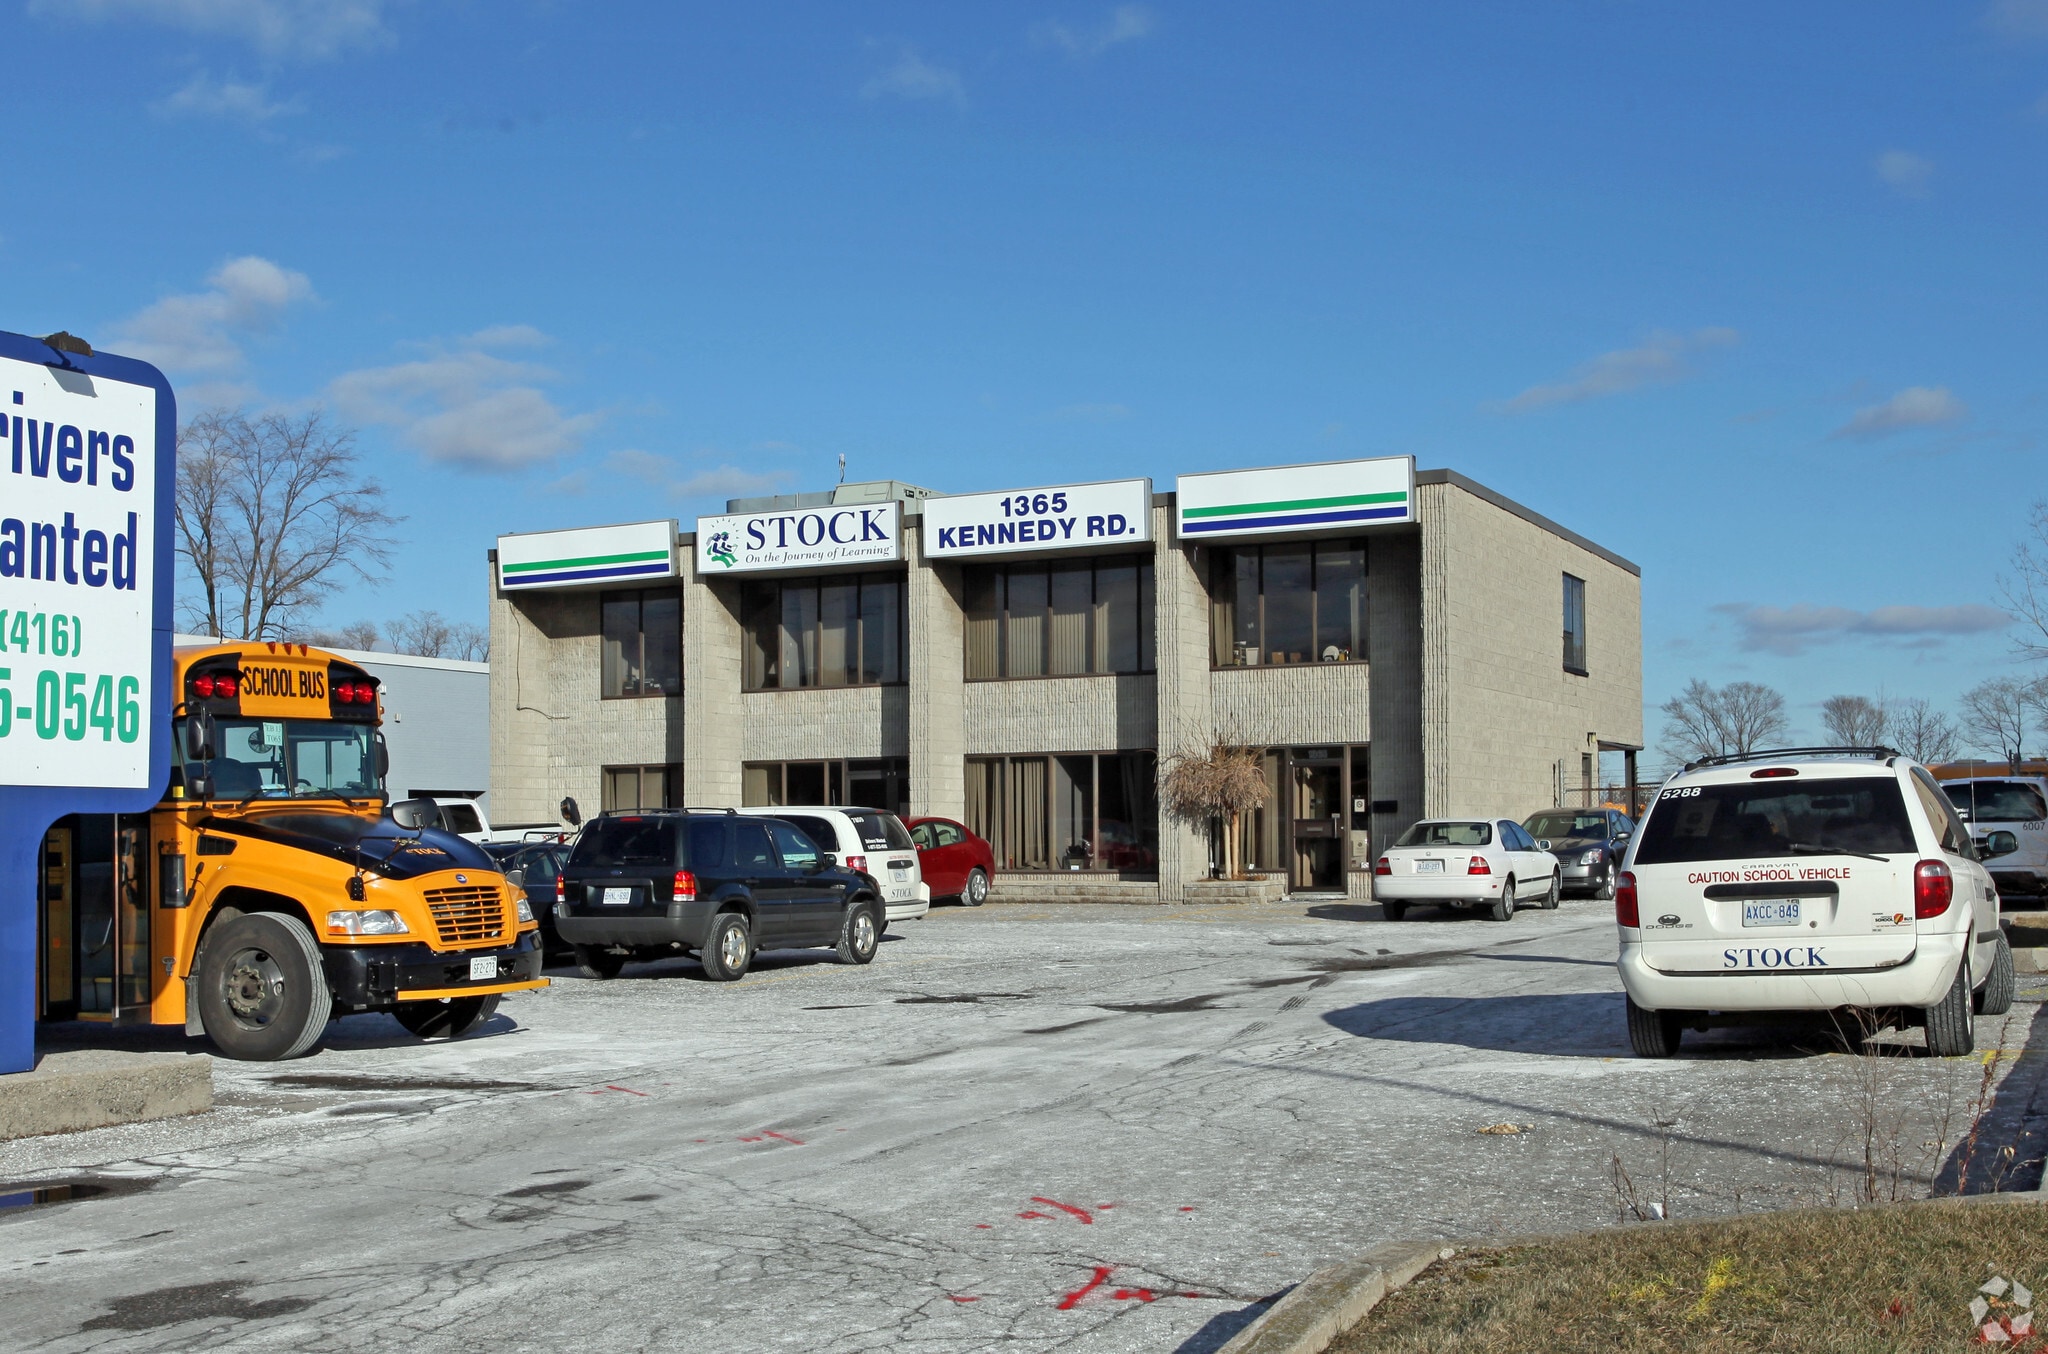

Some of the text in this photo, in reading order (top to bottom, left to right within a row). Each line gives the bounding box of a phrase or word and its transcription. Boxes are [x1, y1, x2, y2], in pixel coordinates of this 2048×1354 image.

[1000, 492, 1068, 517] 1365
[746, 508, 890, 551] STOCK
[938, 513, 1136, 549] KENNEDY RD.
[0, 511, 137, 591] anted
[745, 545, 890, 564] On the Journey of Learning
[0, 609, 82, 658] (416)
[243, 666, 325, 699] SCHOOL BUS
[1661, 787, 1702, 800] 5288
[2022, 821, 2046, 831] 6007
[1688, 867, 1851, 884] CAUTION SCHOOL VEHICLE
[1741, 862, 1799, 870] CARAVAN
[891, 888, 912, 899] STOCK
[1723, 946, 1829, 969] STOCK
